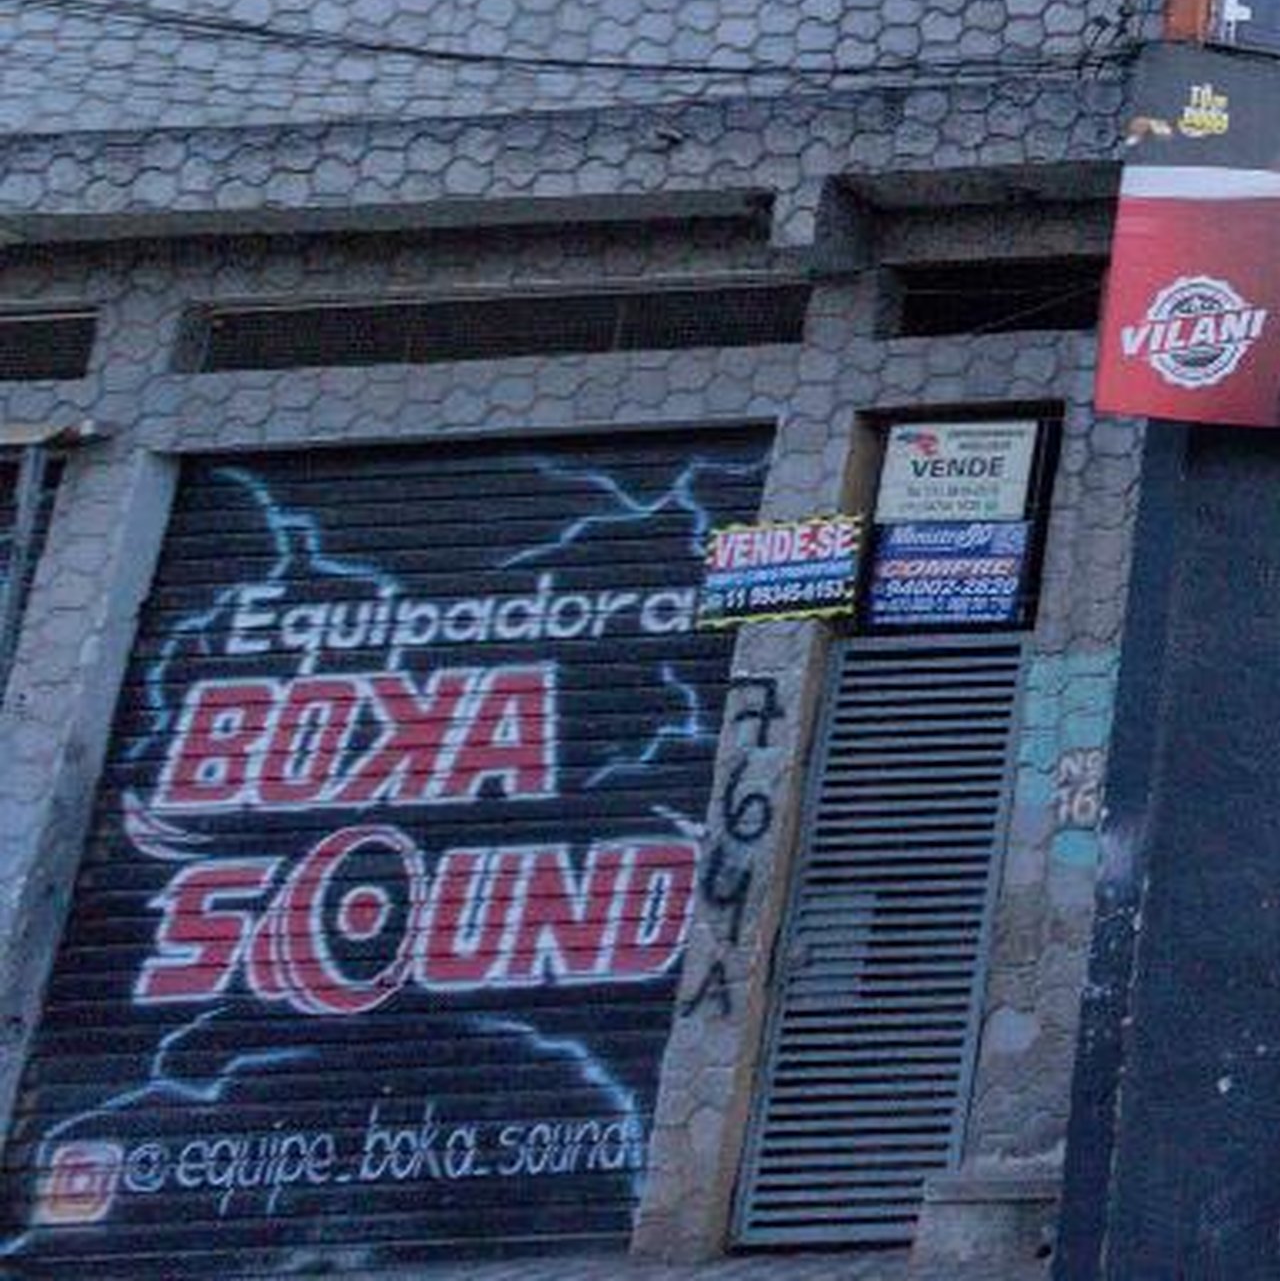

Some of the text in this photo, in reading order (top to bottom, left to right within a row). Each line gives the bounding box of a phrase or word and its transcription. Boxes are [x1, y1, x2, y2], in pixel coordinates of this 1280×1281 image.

[1120, 309, 1268, 358] VILANI
[910, 455, 1005, 478] VENDE
[225, 572, 698, 675] Equipadora
[131, 824, 702, 1015] SOUND
